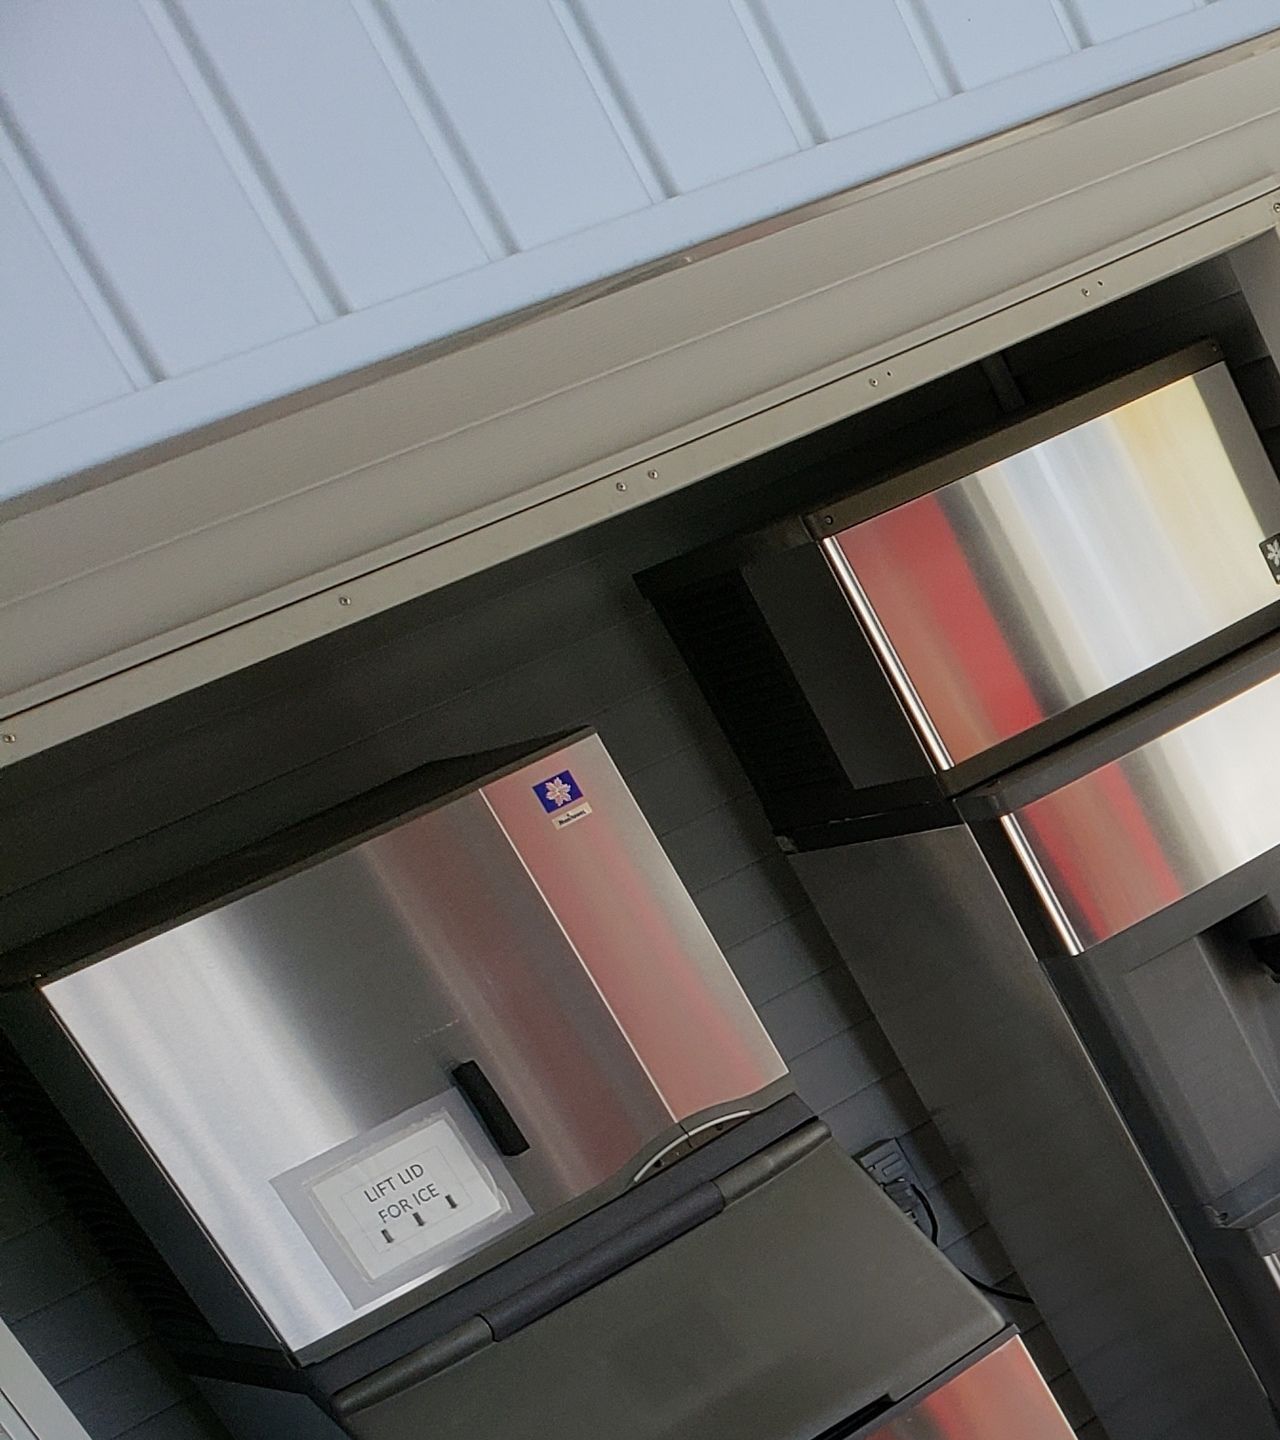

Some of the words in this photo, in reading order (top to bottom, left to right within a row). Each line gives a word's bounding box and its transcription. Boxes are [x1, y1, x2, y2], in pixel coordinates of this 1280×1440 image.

[364, 1177, 396, 1202] LIFT
[397, 1164, 424, 1184] LID
[378, 1199, 413, 1224] FOR
[412, 1183, 440, 1206] ICE
